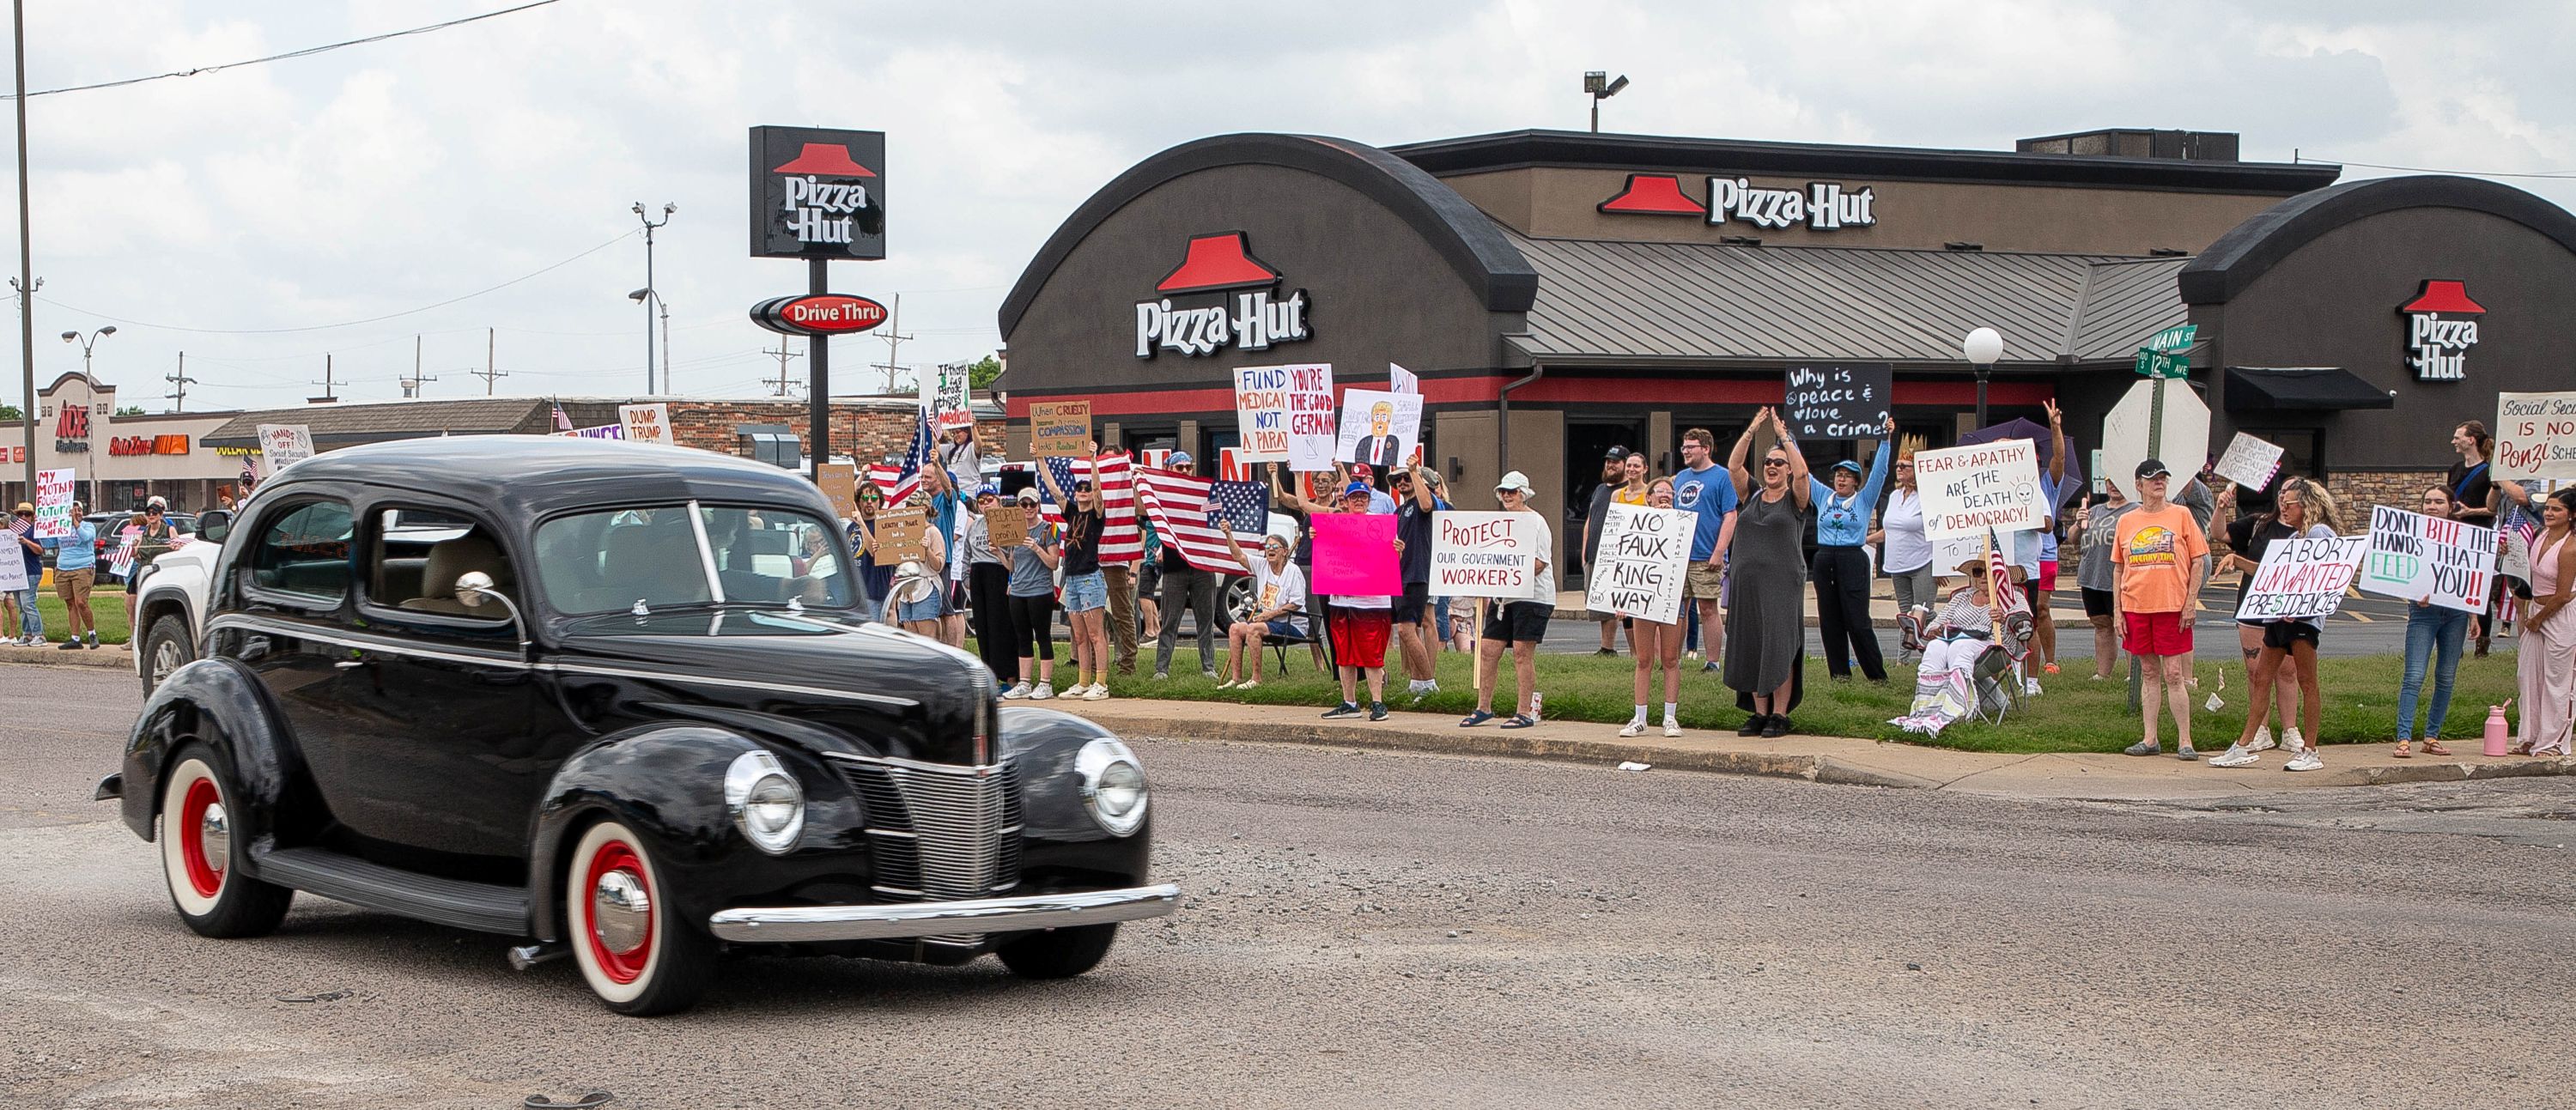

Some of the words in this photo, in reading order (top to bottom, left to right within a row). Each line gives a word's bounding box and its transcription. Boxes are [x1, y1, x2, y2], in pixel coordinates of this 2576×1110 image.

[785, 175, 866, 213] Pizza
[1711, 178, 1804, 227] Pizza
[1806, 184, 1874, 227] Hut
[787, 207, 854, 243] Hut
[794, 305, 840, 322] Drive
[841, 302, 880, 321] Thru
[1136, 299, 1229, 356] Pizza
[1231, 292, 1303, 349] Hut
[2411, 312, 2479, 349] Pizza
[2184, 331, 2196, 342] ST
[2175, 364, 2188, 375] AVE
[2413, 344, 2467, 379] Hut
[1242, 369, 1286, 391] FUND
[1290, 368, 1323, 392] YOU'RE
[1789, 367, 1826, 390] Why
[1834, 367, 1851, 383] is
[1238, 391, 1286, 410] MEDICAI
[1290, 393, 1307, 411] THE
[1309, 393, 1333, 412] GOOD
[1799, 389, 1855, 408] peace
[2502, 399, 2549, 416] Social
[55, 399, 88, 438] ACE
[629, 409, 656, 424] DUMP
[1031, 406, 1054, 417] When
[1255, 411, 1282, 429] NOT
[1805, 406, 1843, 421] love
[270, 428, 295, 440] HANDS
[630, 425, 661, 440] TRUMP
[1291, 413, 1335, 435] GERMAN
[1804, 423, 1817, 434] a
[2518, 422, 2535, 436] IS
[109, 436, 154, 457] AutoZone
[1242, 432, 1252, 451] A
[1917, 457, 1954, 473] FEAR
[1957, 454, 1969, 467] &
[1971, 446, 2026, 467] APATHY
[2500, 437, 2551, 474] Ponzi
[38, 471, 56, 484] MY
[1946, 478, 1971, 497] ARE
[1971, 470, 2001, 489] THE
[1963, 490, 2013, 509] DEATH
[989, 508, 1023, 523] PEOPLE
[1630, 513, 1664, 532] NO
[1929, 513, 1941, 531] of
[1946, 506, 2029, 530] DEMOCRACY!
[1443, 519, 1515, 547] PROTECT
[2426, 517, 2464, 548] BITE
[2470, 527, 2498, 555] THE
[1619, 533, 1668, 560] FAUX
[2273, 537, 2366, 563] ABORT
[2372, 531, 2424, 557] HANDS
[2430, 542, 2487, 569] THAT
[1437, 552, 1456, 564] OUR
[1461, 553, 1526, 567] GOVERNMENT
[1443, 568, 1522, 585] WORKER'S
[1613, 561, 1662, 597] KING
[2254, 562, 2354, 592] UNWANTED
[2371, 552, 2420, 579] FEED
[2430, 562, 2483, 607] YOU!!
[1611, 591, 1656, 616] WAY!
